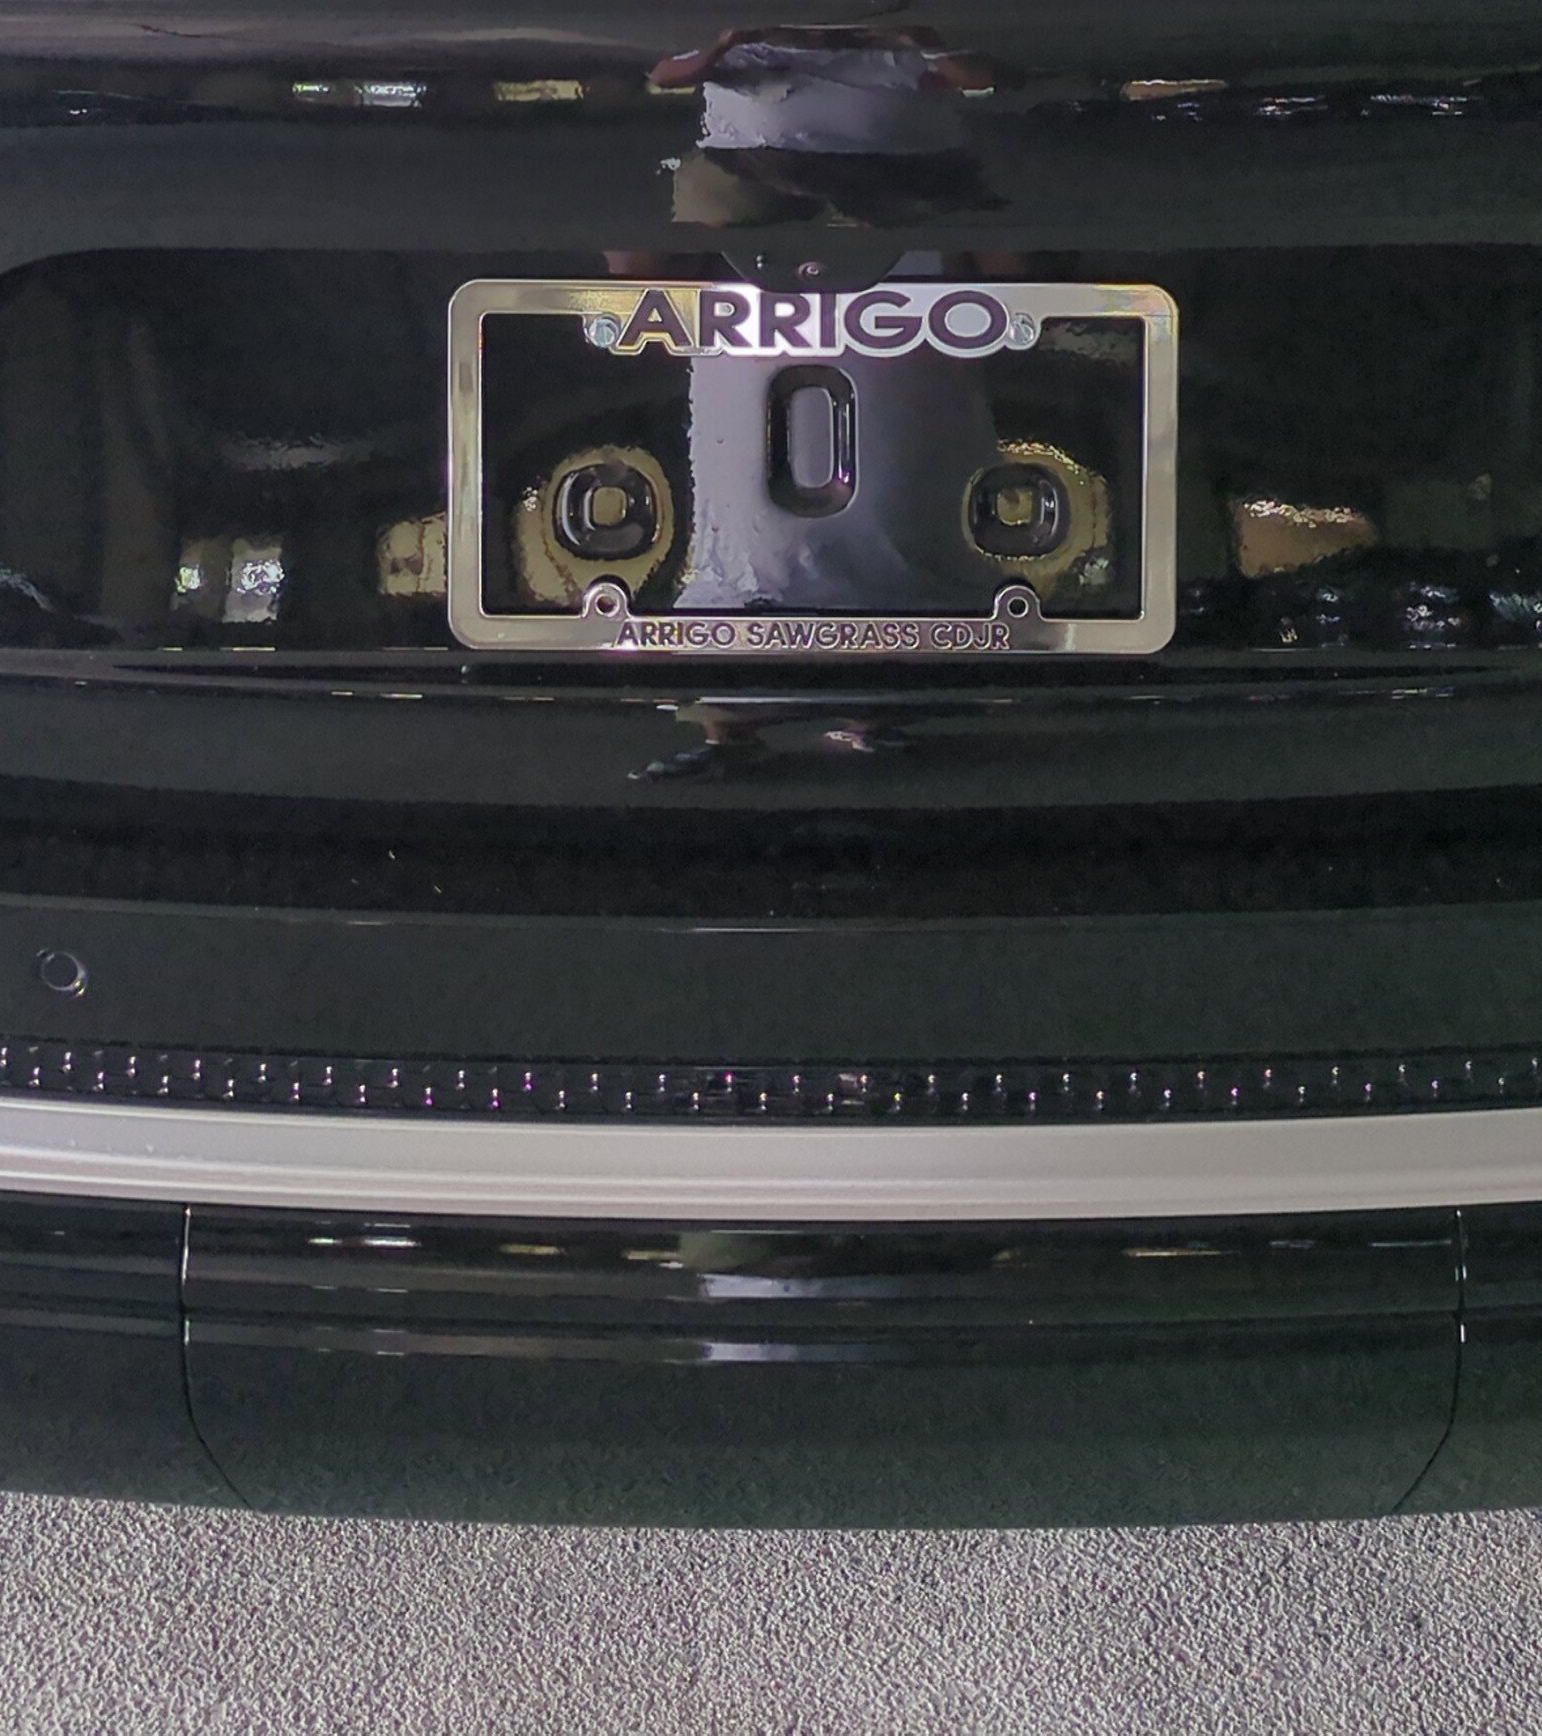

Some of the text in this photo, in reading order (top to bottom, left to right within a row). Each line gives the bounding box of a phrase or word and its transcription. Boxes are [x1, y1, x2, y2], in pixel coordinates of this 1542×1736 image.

[616, 287, 1009, 351] ARRIGO
[614, 620, 1011, 650] ARRIGO SAWGRASS CDJR
